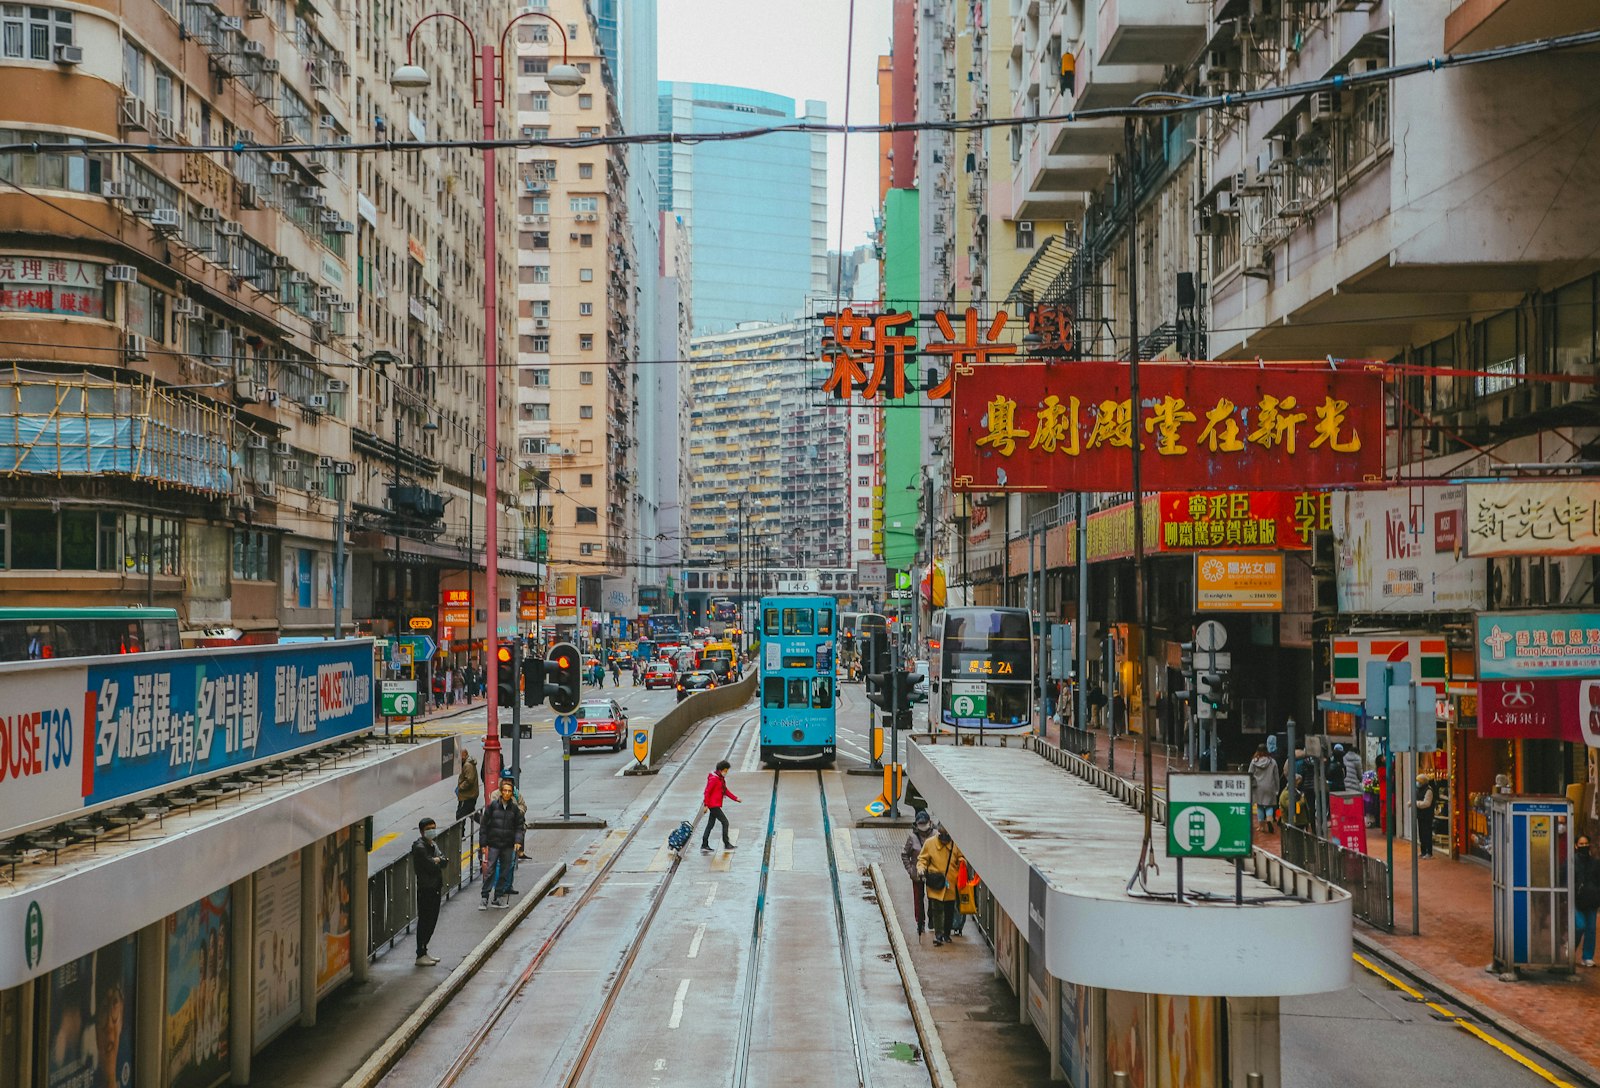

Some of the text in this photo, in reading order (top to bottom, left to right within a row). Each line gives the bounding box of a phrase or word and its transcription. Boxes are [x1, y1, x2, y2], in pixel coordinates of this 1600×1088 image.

[788, 583, 810, 591] 146
[1516, 646, 1540, 657] Hong
[1541, 645, 1564, 656] Kong
[1565, 645, 1590, 656] Grace
[997, 661, 1013, 674] 2A
[1492, 711, 1547, 725] 大新銀行
[1214, 780, 1246, 789] 書局街
[1229, 806, 1246, 815] 71E
